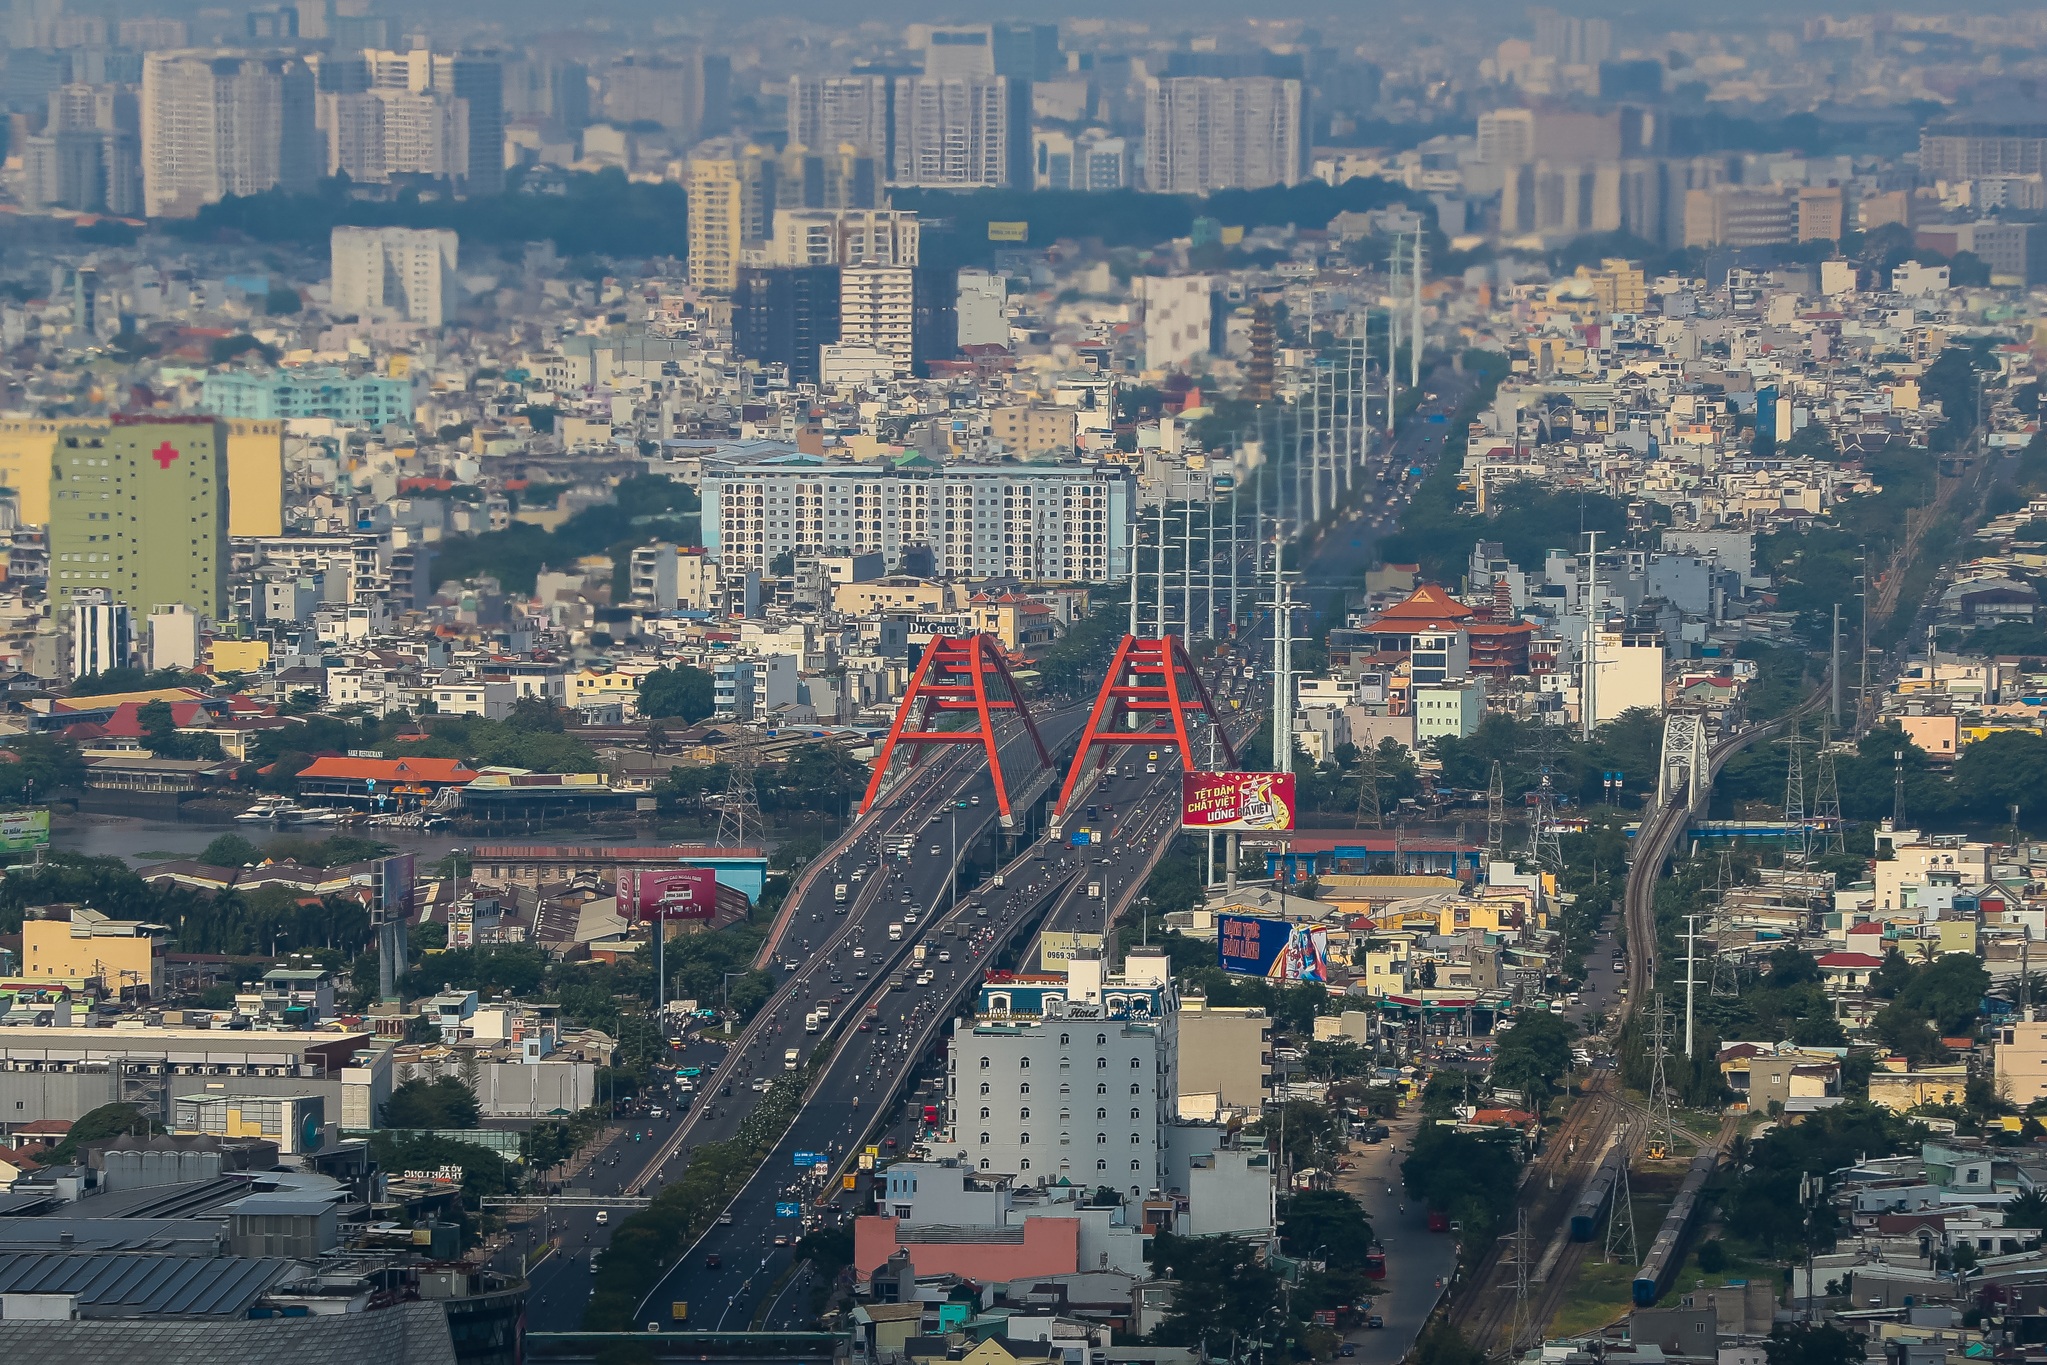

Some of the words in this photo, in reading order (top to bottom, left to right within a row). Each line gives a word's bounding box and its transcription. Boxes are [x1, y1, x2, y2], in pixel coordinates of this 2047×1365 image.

[909, 622, 955, 633] Dr.Care
[1194, 787, 1213, 799] TẾT
[1188, 799, 1215, 813] CHẤT
[1214, 796, 1236, 808] VIỆT
[1207, 808, 1235, 821] UỐNG
[1068, 1008, 1099, 1018] Hotel
